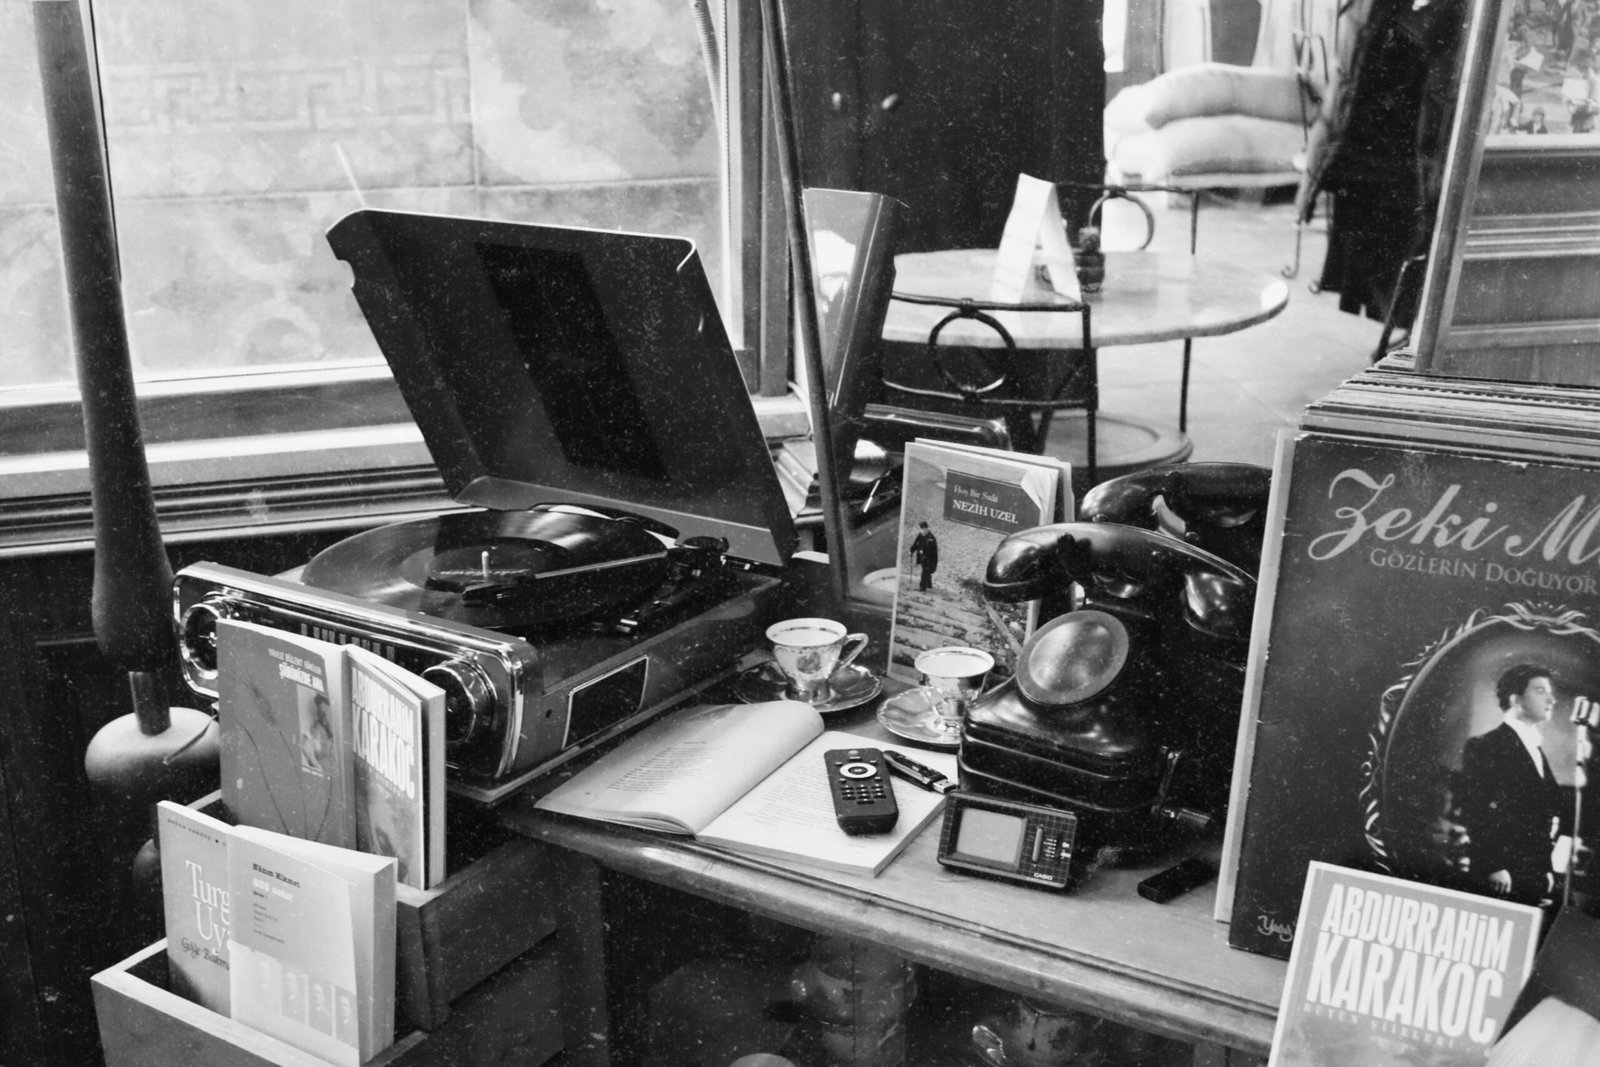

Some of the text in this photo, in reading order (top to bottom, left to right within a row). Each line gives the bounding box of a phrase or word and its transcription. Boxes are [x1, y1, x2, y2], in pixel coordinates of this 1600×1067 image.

[990, 507, 1019, 524] UZEL
[1307, 468, 1600, 565] Zeki M
[1319, 882, 1515, 973] ABDURRAHİM
